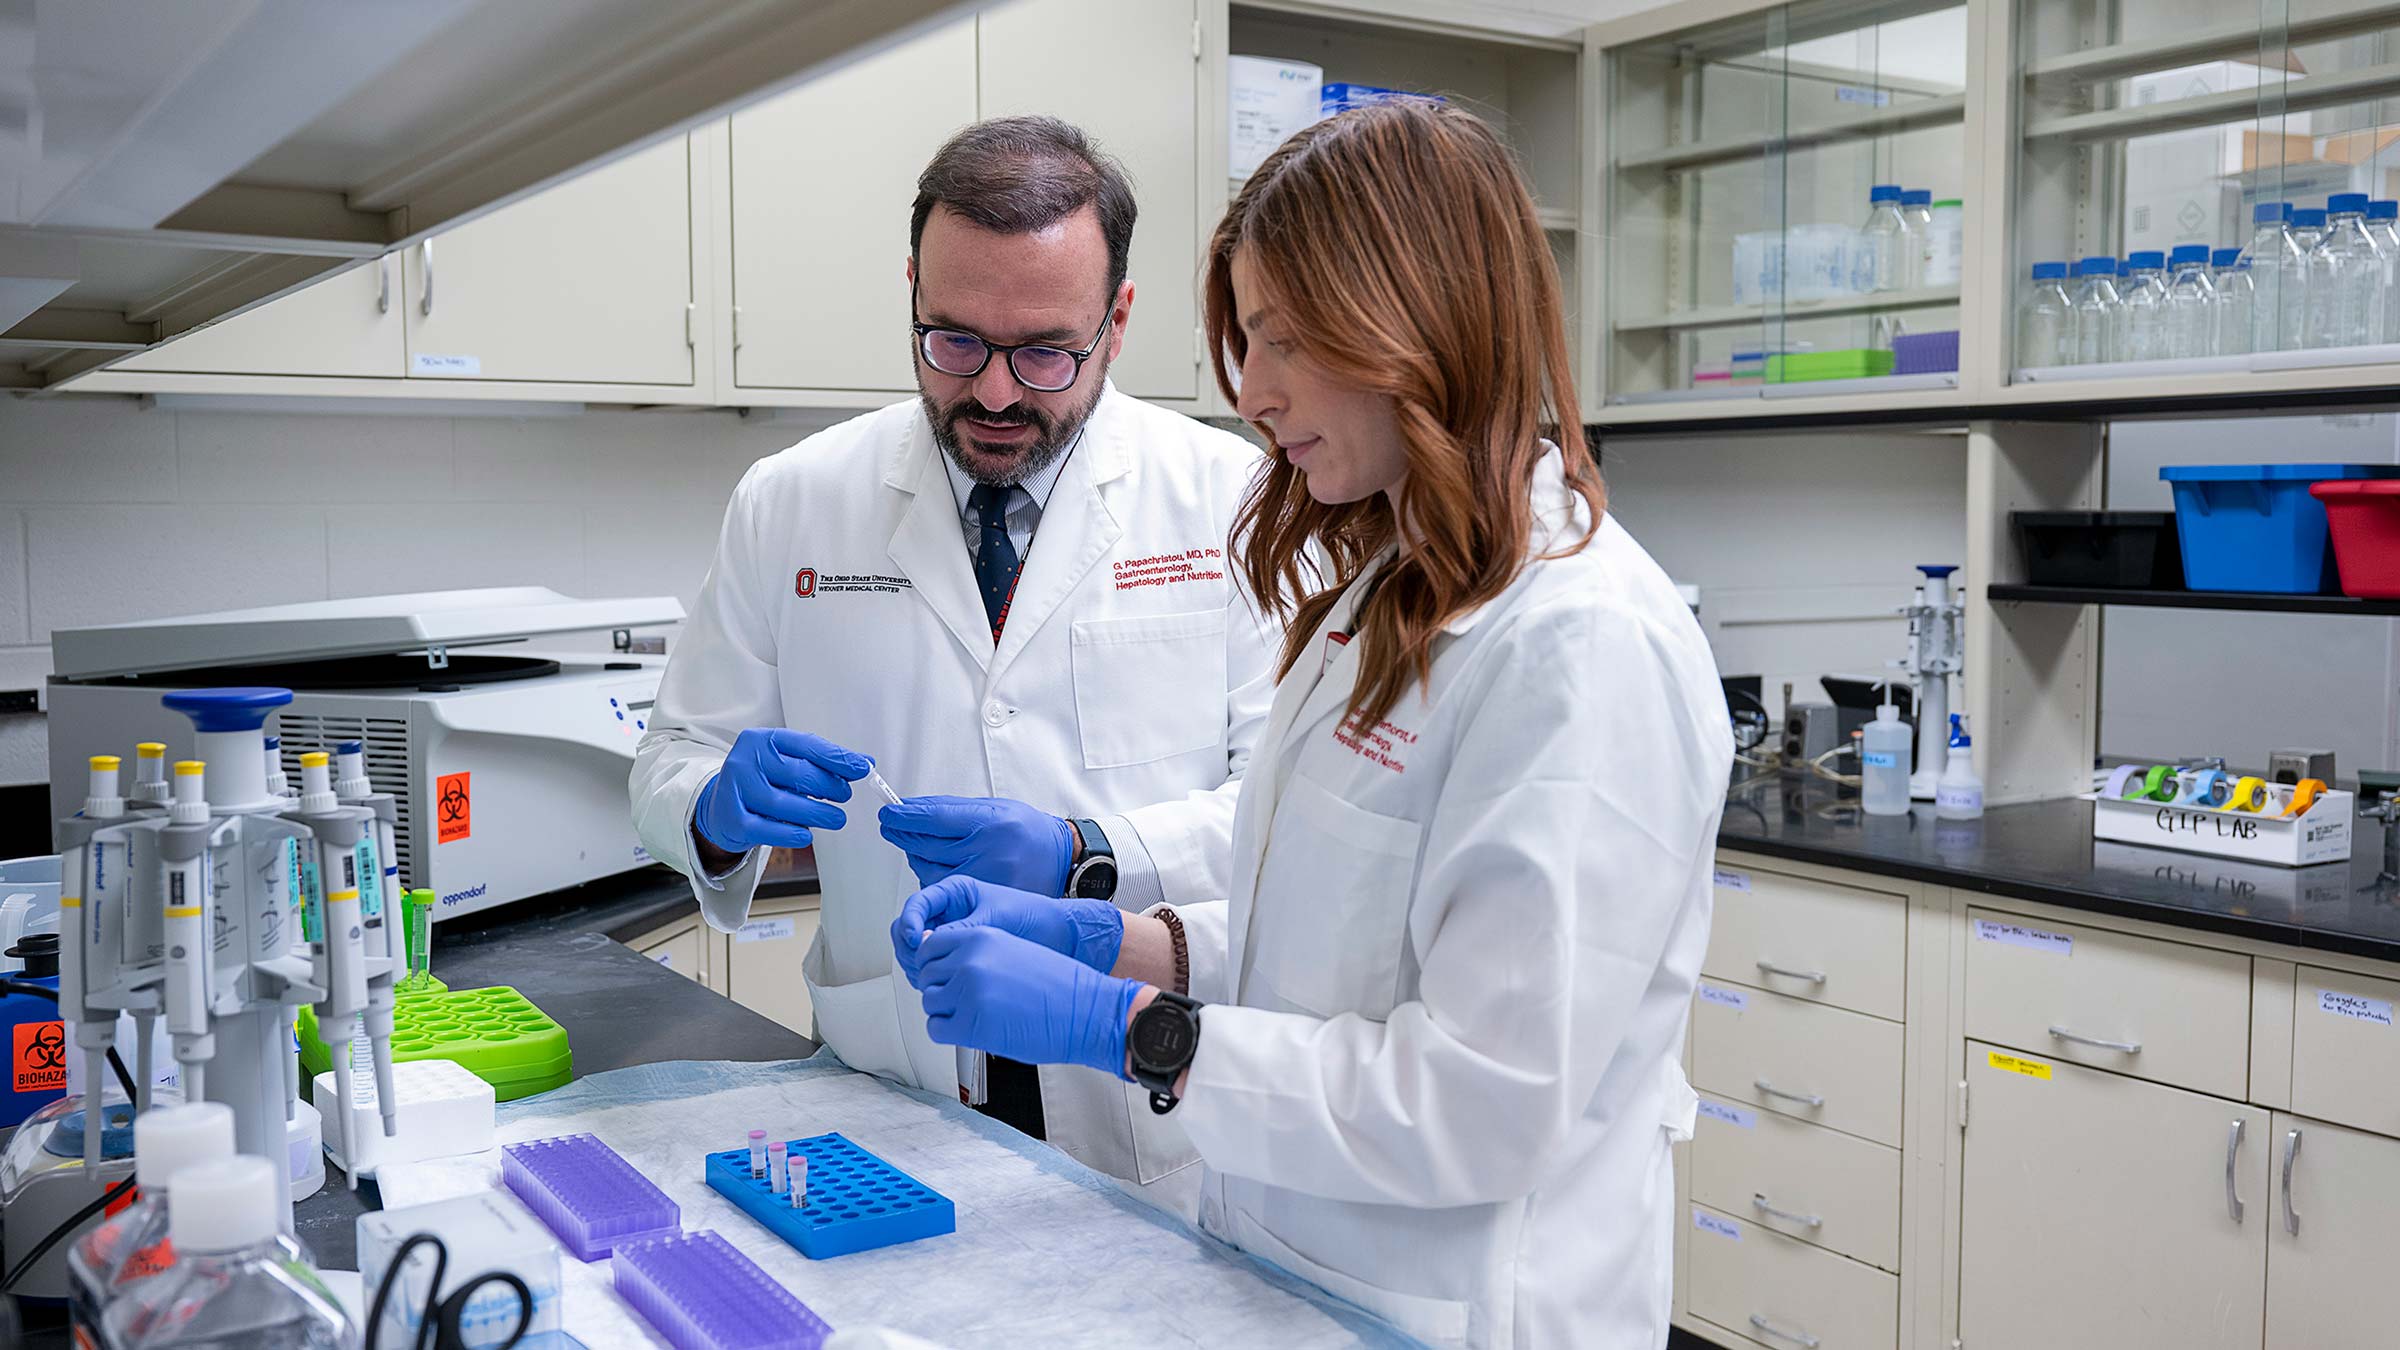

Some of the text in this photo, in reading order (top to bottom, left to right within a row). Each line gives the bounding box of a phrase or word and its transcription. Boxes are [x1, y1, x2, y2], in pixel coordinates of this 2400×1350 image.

[1124, 554, 1185, 570] Papachristou,
[1186, 549, 1204, 560] MD,
[1205, 548, 1221, 558] PhD
[1114, 563, 1193, 581] Gastroenterology,
[1116, 571, 1223, 591] Hepatology and Nutrition
[873, 585, 900, 593] CENTER
[440, 824, 468, 837] BIOHAZARD
[2216, 816, 2258, 840] LAB
[442, 883, 487, 906] eppendorf
[18, 1070, 67, 1085] BIOHAZA
